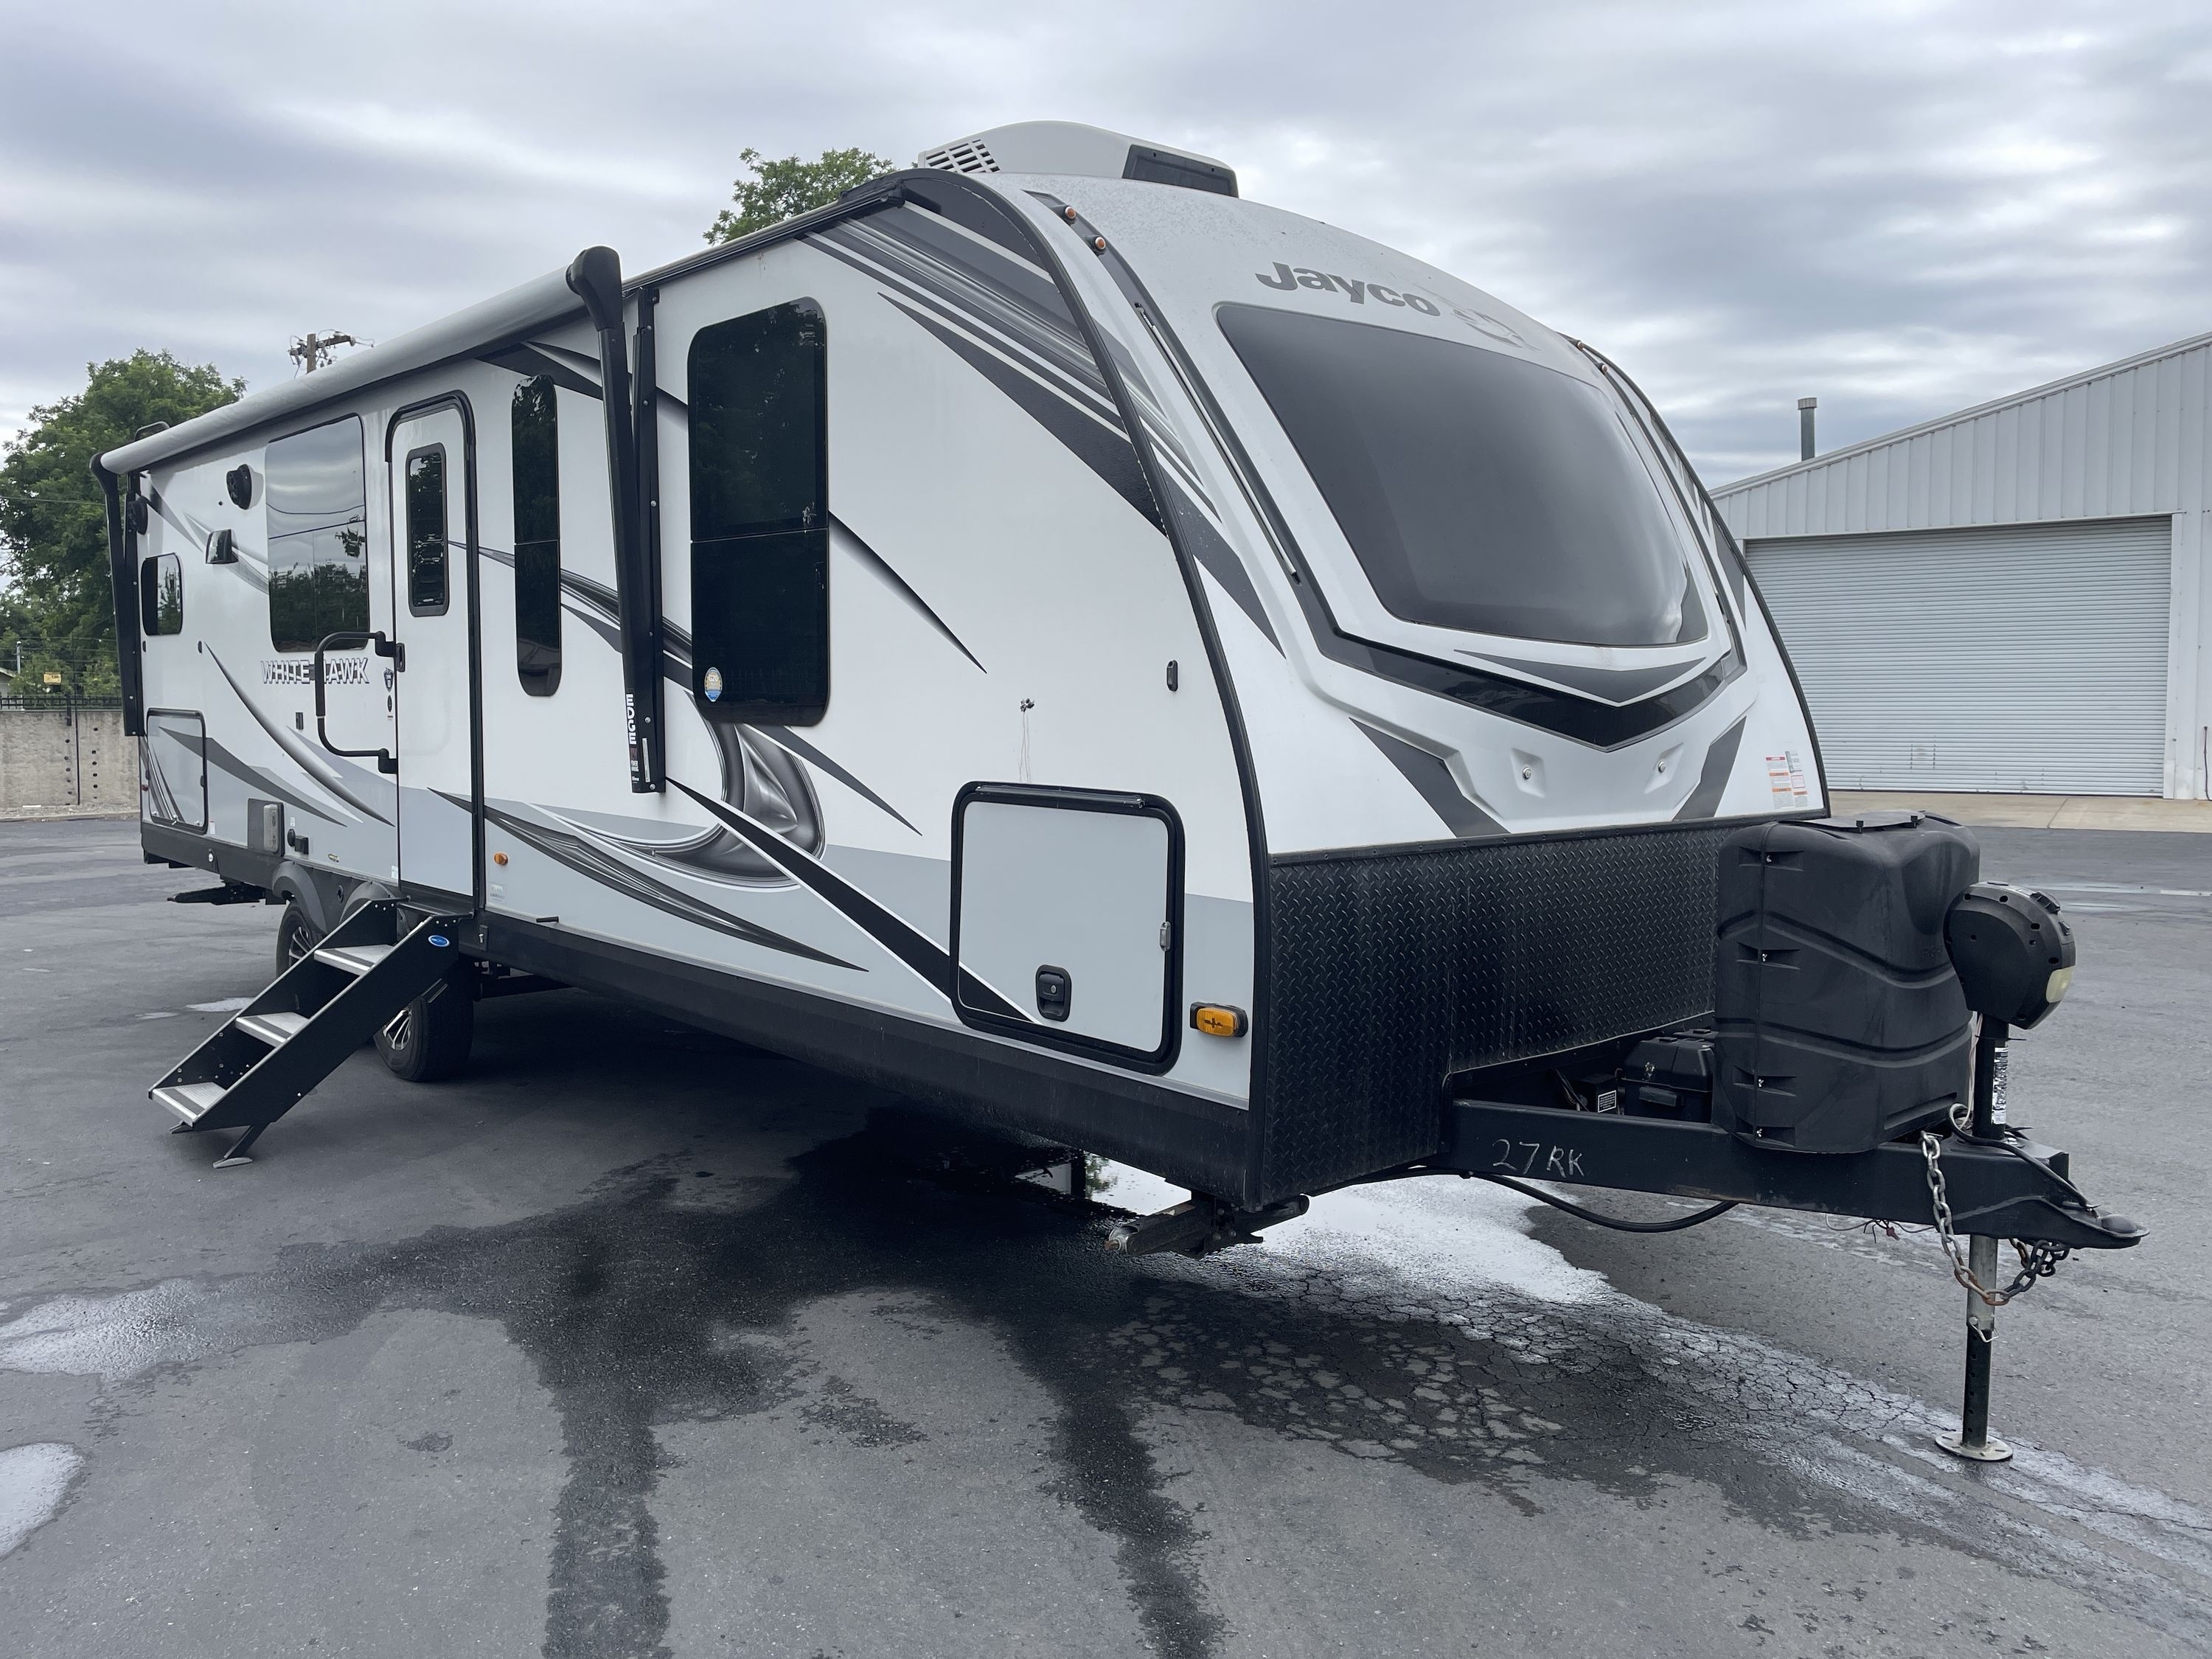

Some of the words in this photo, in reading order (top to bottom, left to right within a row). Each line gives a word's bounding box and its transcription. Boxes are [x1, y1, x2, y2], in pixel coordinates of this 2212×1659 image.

[1255, 262, 1440, 316] Jayco
[260, 659, 310, 684] WHITE
[626, 694, 637, 745] EDGE
